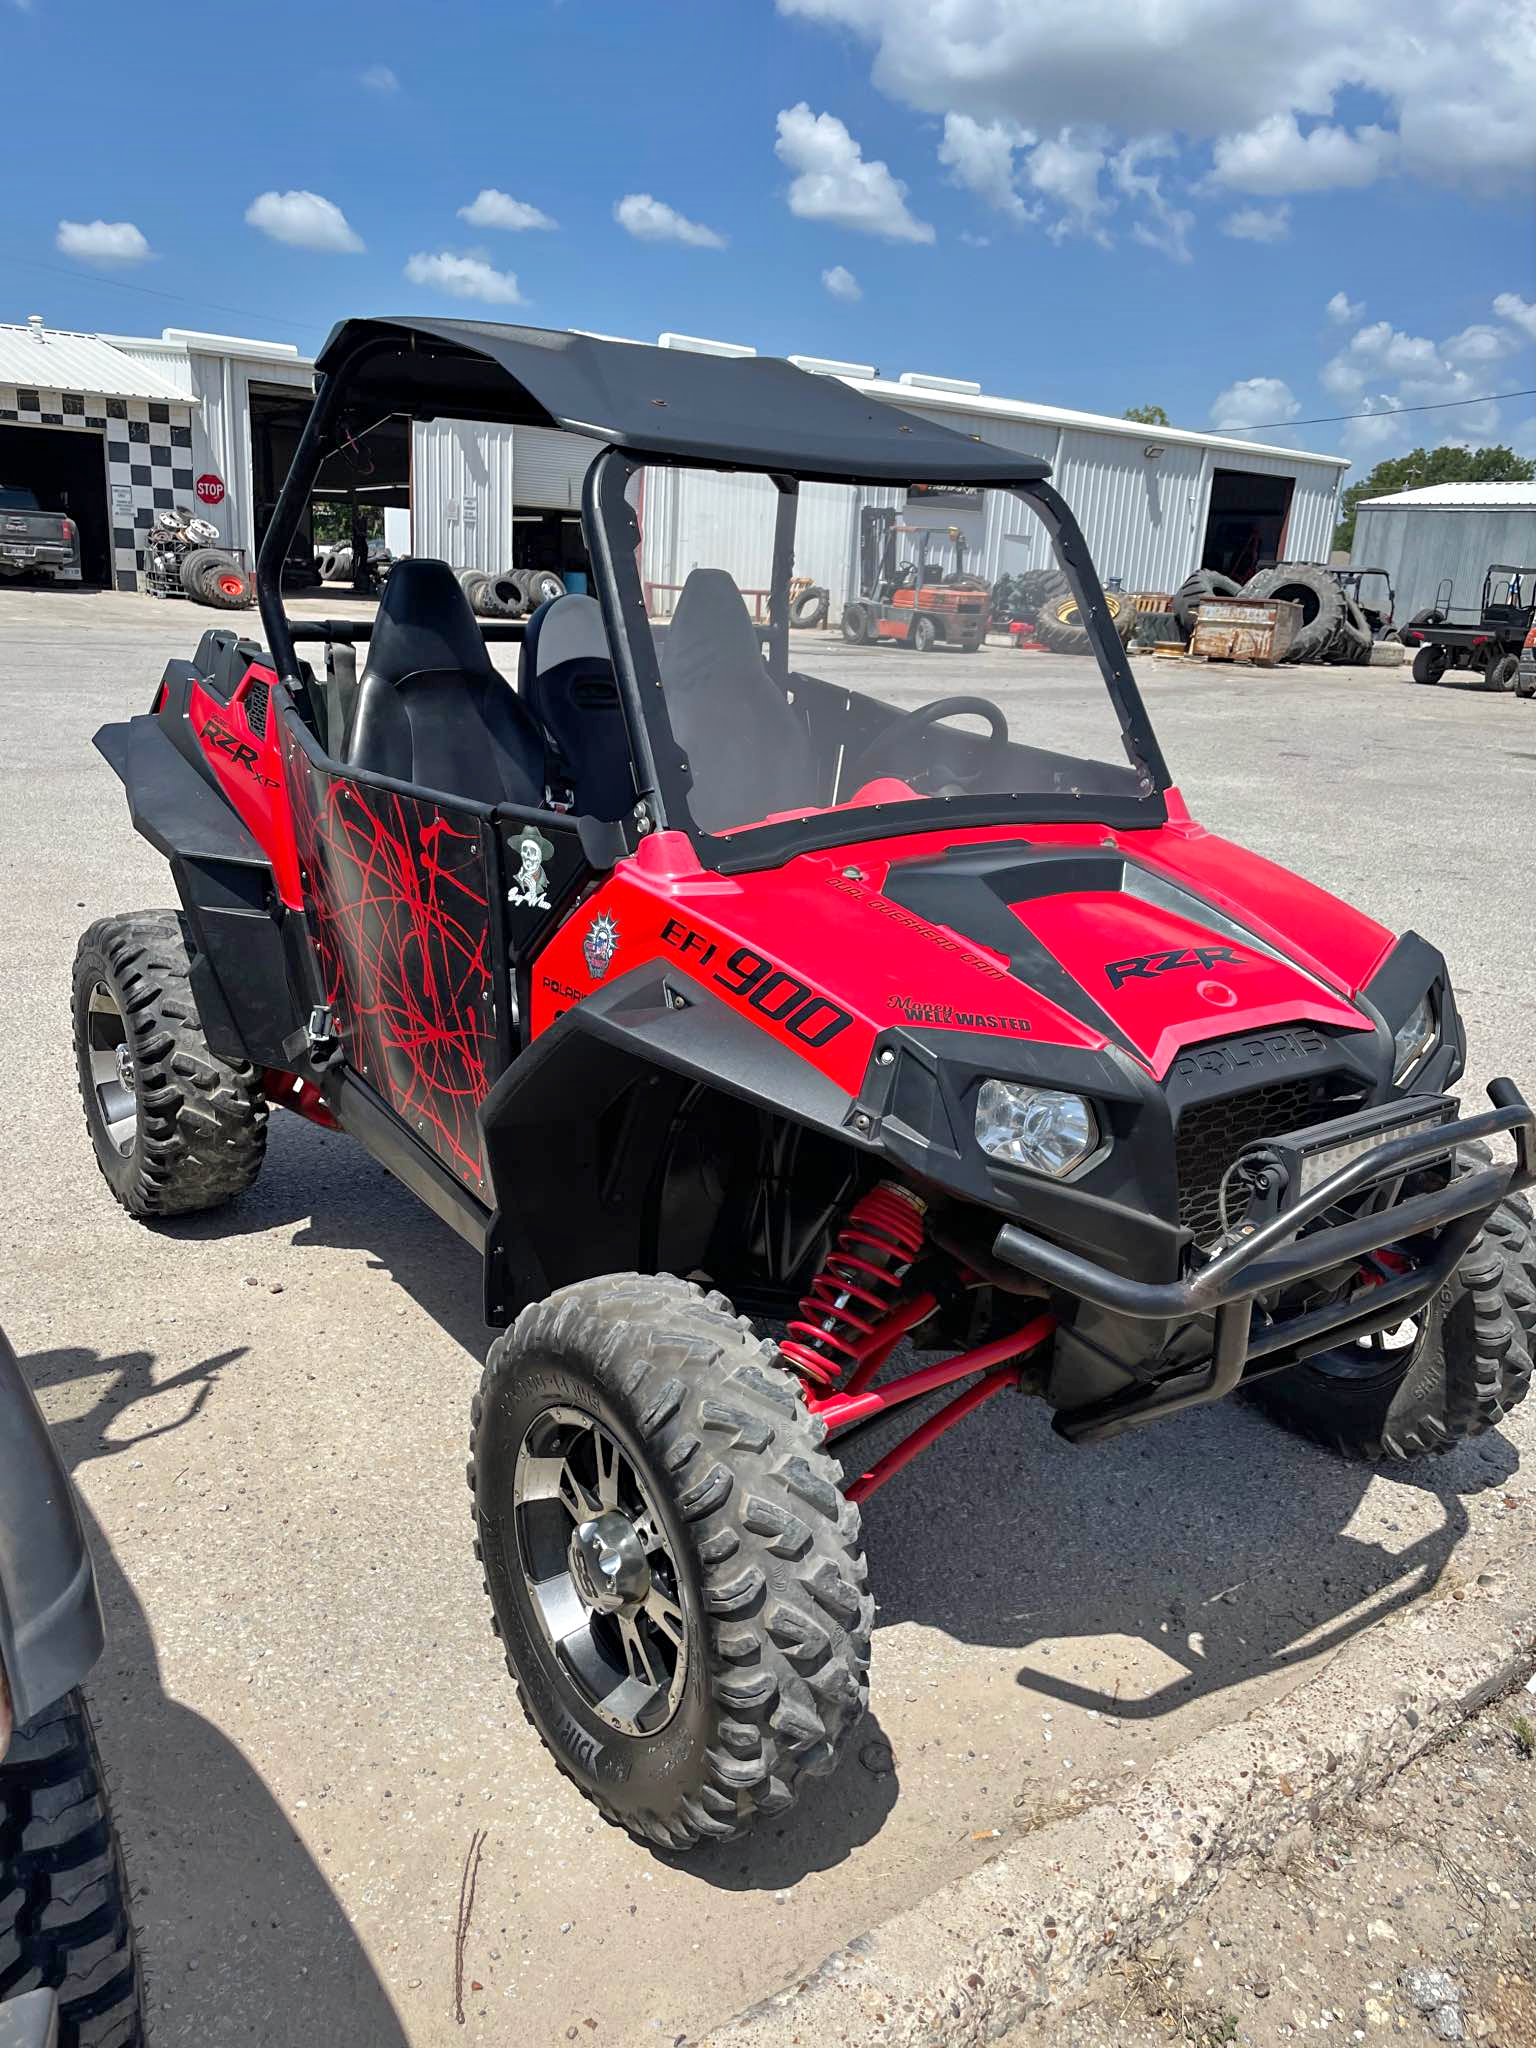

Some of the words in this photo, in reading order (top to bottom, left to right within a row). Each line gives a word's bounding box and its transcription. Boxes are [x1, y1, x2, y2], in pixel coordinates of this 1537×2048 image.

[197, 482, 224, 496] STOP
[200, 719, 259, 774] RZR
[253, 771, 281, 788] XP
[825, 877, 866, 901] DUAL
[960, 952, 1006, 981] CAM
[659, 917, 718, 967] EFI
[712, 947, 855, 1048] 900
[1104, 946, 1248, 991] RZR
[887, 995, 953, 1019] Money
[904, 1008, 953, 1026] WELL
[955, 1012, 1032, 1033] WASTED
[1173, 1026, 1328, 1090] POLARIS
